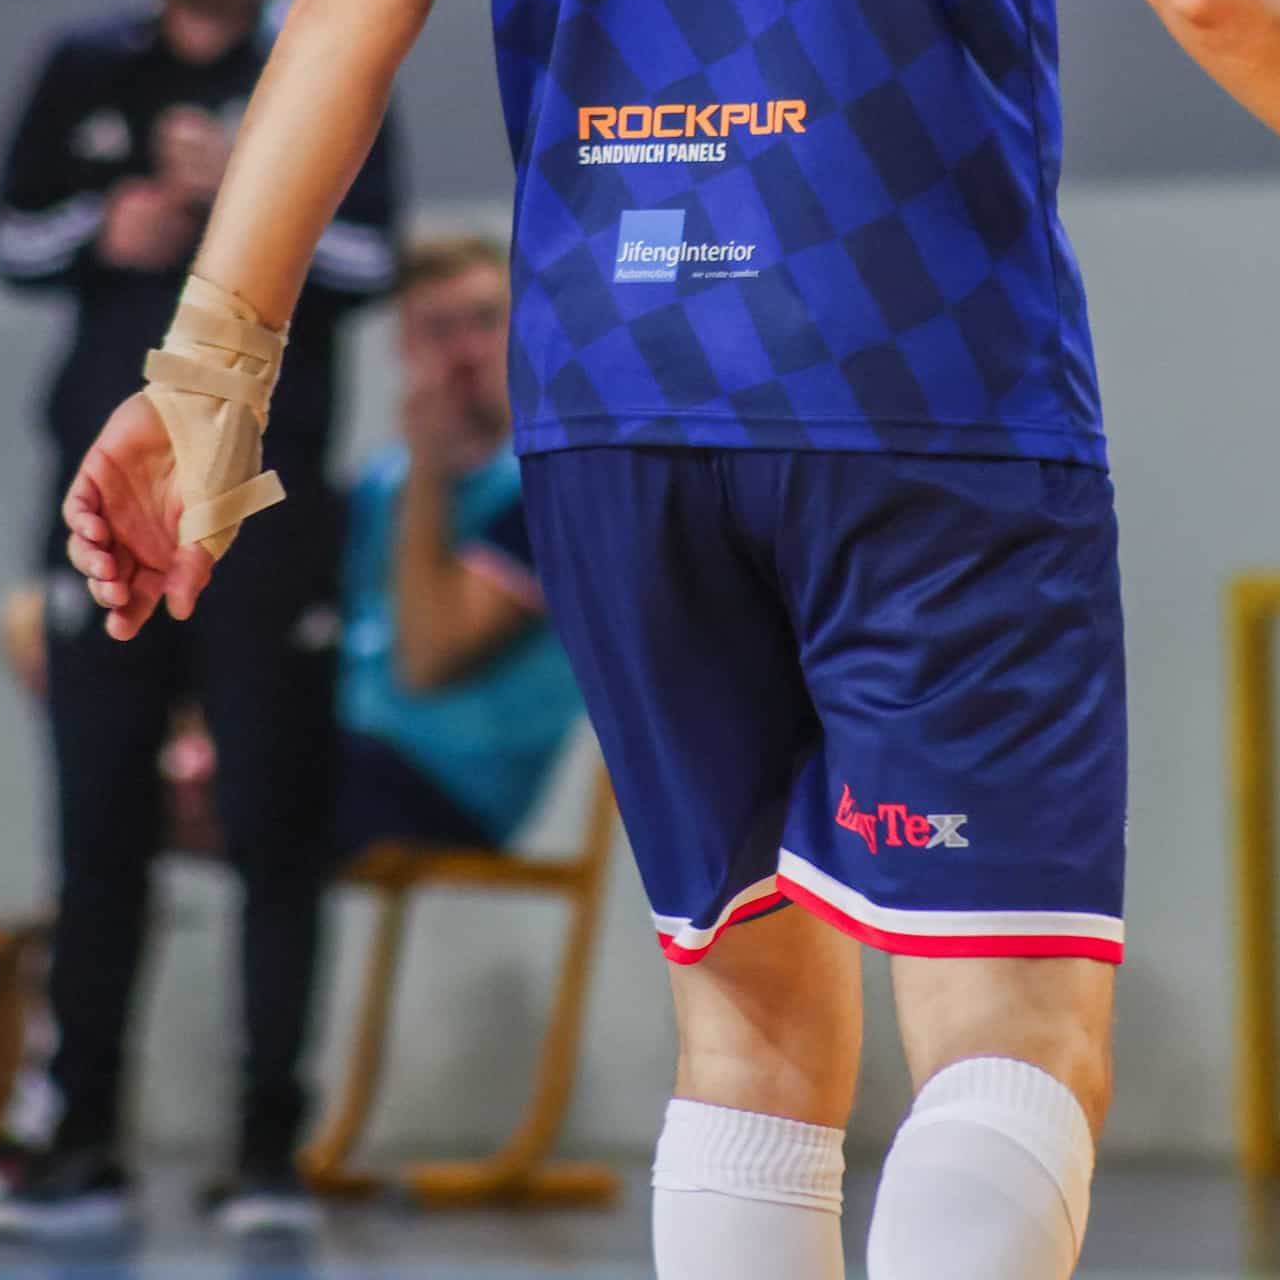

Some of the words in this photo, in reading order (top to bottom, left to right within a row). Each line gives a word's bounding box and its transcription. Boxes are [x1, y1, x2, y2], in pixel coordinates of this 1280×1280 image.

[578, 98, 807, 140] ROCKPUR
[578, 142, 665, 165] SANDWICH
[666, 141, 727, 163] PANELS
[616, 240, 756, 267] JifengInterior
